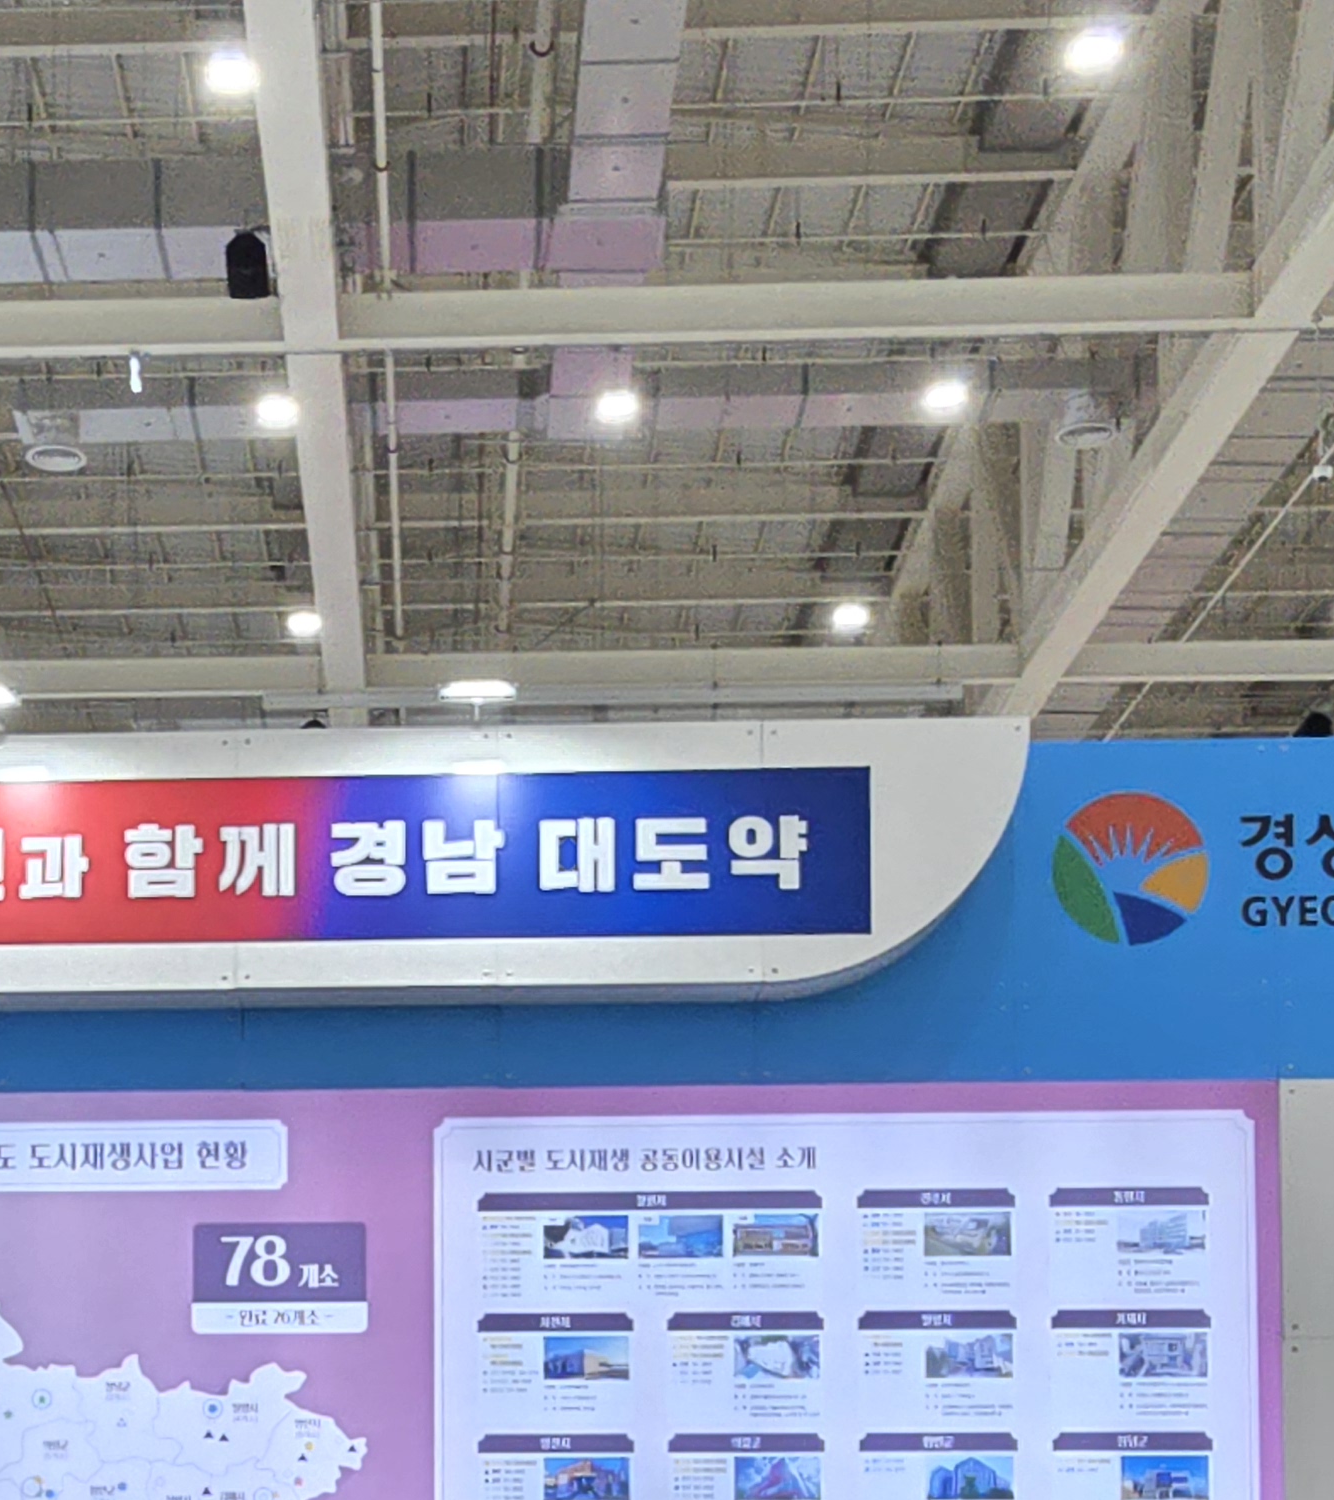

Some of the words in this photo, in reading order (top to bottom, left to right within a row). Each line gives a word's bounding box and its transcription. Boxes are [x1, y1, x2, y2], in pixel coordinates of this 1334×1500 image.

[124, 822, 296, 898] 함께
[329, 818, 505, 897] 경남
[539, 814, 809, 893] 대도약
[29, 1141, 184, 1171] 도시재생사업
[197, 1140, 248, 1171] 현황
[472, 1149, 537, 1173] 시군별
[545, 1148, 630, 1172] 도시재생
[640, 1147, 766, 1172] 공동이용시설
[776, 1146, 818, 1170] 소개
[220, 1234, 292, 1288] 78
[298, 1263, 340, 1288] 개소
